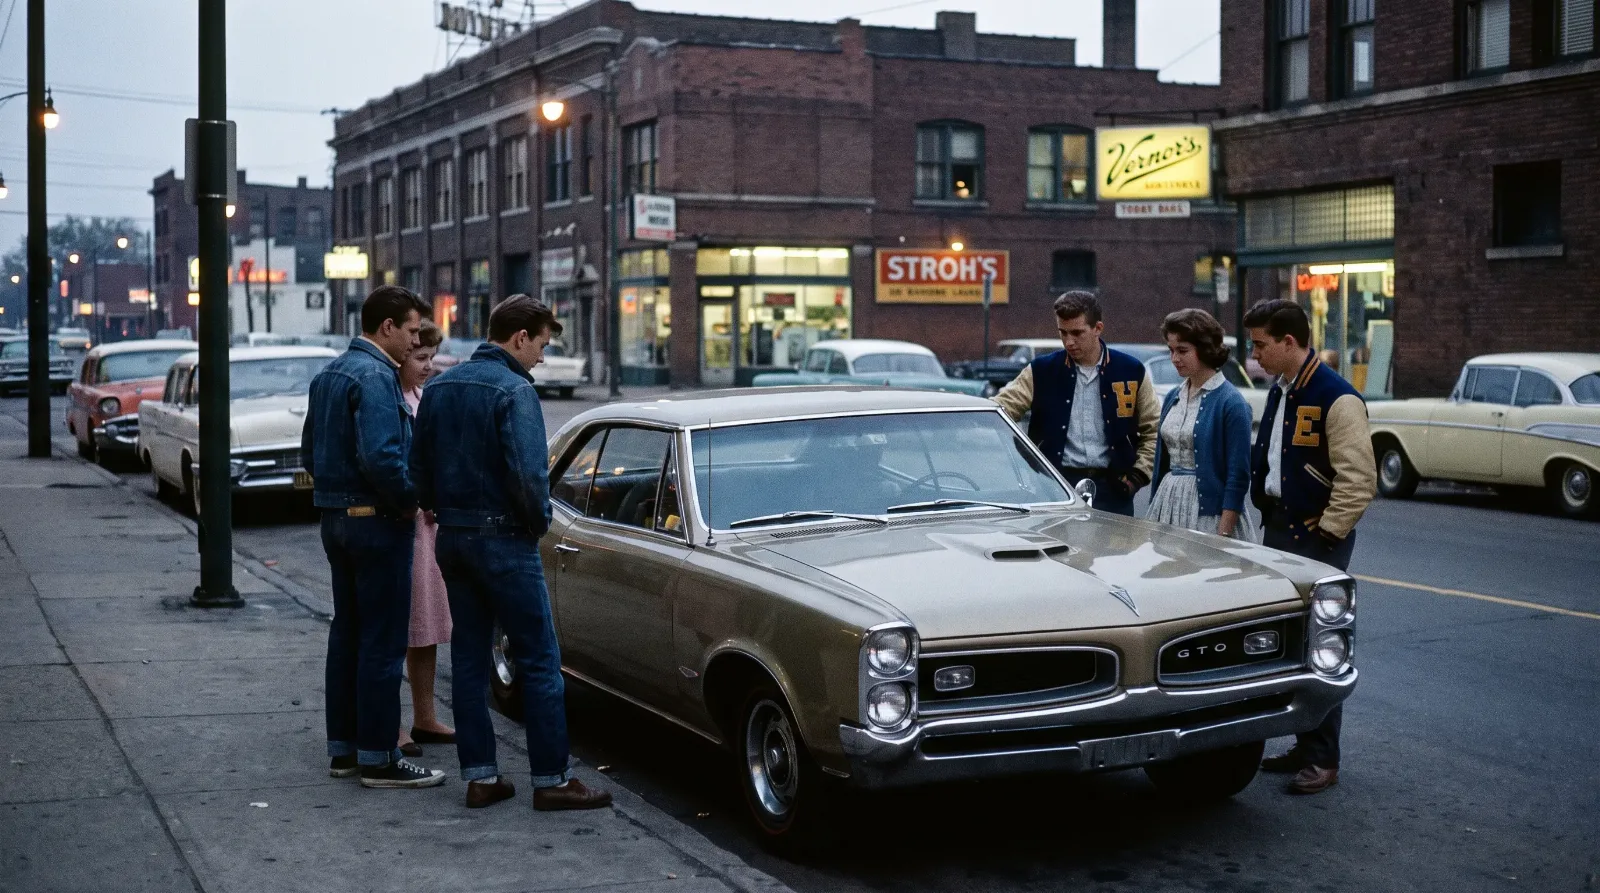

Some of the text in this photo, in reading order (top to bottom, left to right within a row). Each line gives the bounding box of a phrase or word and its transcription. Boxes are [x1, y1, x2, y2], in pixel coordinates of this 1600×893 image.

[887, 255, 998, 281] STROH'S
[1111, 380, 1139, 418] H
[1291, 405, 1322, 447] E
[1177, 643, 1227, 658] GTO
